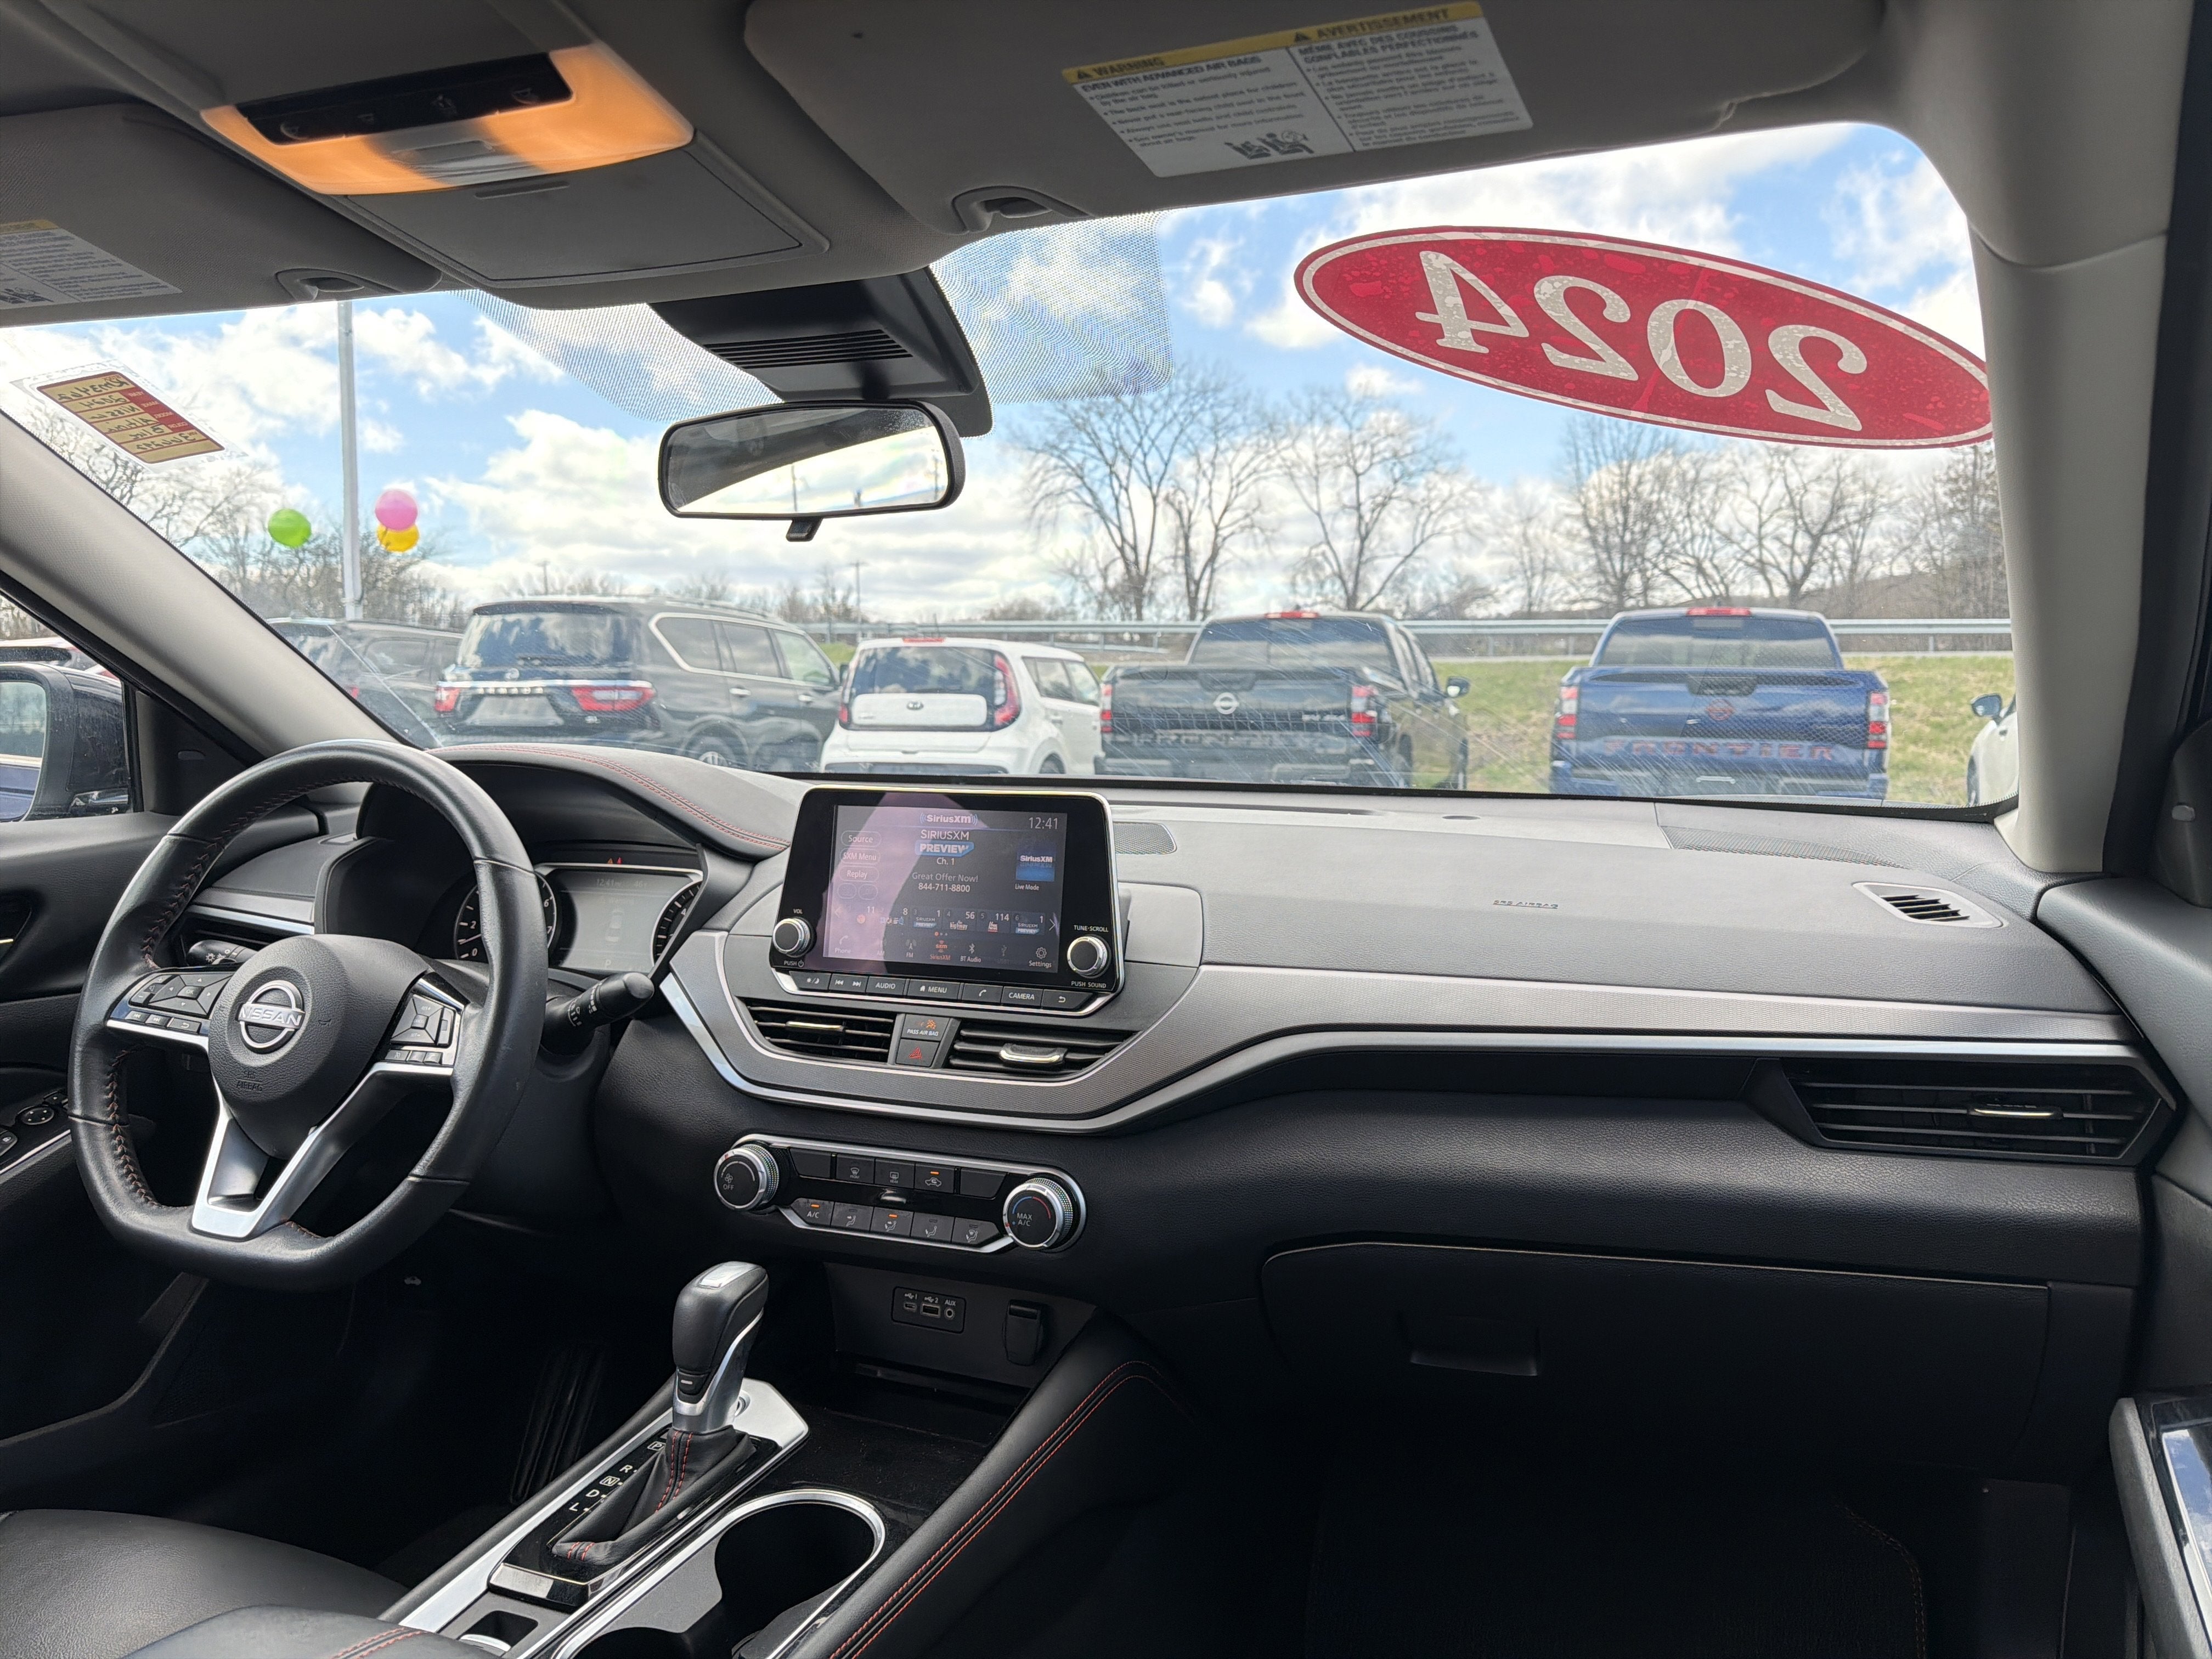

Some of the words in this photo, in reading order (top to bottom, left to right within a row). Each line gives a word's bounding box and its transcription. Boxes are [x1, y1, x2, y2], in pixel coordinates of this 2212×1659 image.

[1091, 57, 1167, 76] WARNING
[1603, 738, 1833, 761] FRONTIER
[1029, 817, 1058, 830] 12:41
[920, 829, 969, 840] SIRIUSXM
[919, 844, 969, 854] PREVIEW
[843, 851, 857, 860] SXM
[859, 853, 877, 861] Menu
[936, 857, 949, 865] Ch.
[847, 870, 867, 879] Replay
[912, 872, 933, 880] Great
[935, 873, 956, 881] Offer
[958, 874, 978, 882] Now!
[918, 882, 970, 893] 844-711-8800
[544, 899, 549, 907] 6
[867, 906, 875, 914] 11
[902, 907, 908, 916] 8
[995, 913, 1009, 921] 114
[470, 920, 476, 929] 2
[472, 948, 478, 957] 0
[1029, 960, 1052, 968] Settings
[1008, 992, 1035, 1000] CAMERA
[239, 1006, 301, 1026] NISSAN
[807, 1211, 820, 1219] A/C
[1017, 1212, 1032, 1221] MAX
[620, 1464, 633, 1473] R
[605, 1477, 616, 1486] N
[586, 1489, 599, 1498] D
[569, 1502, 579, 1511] L
